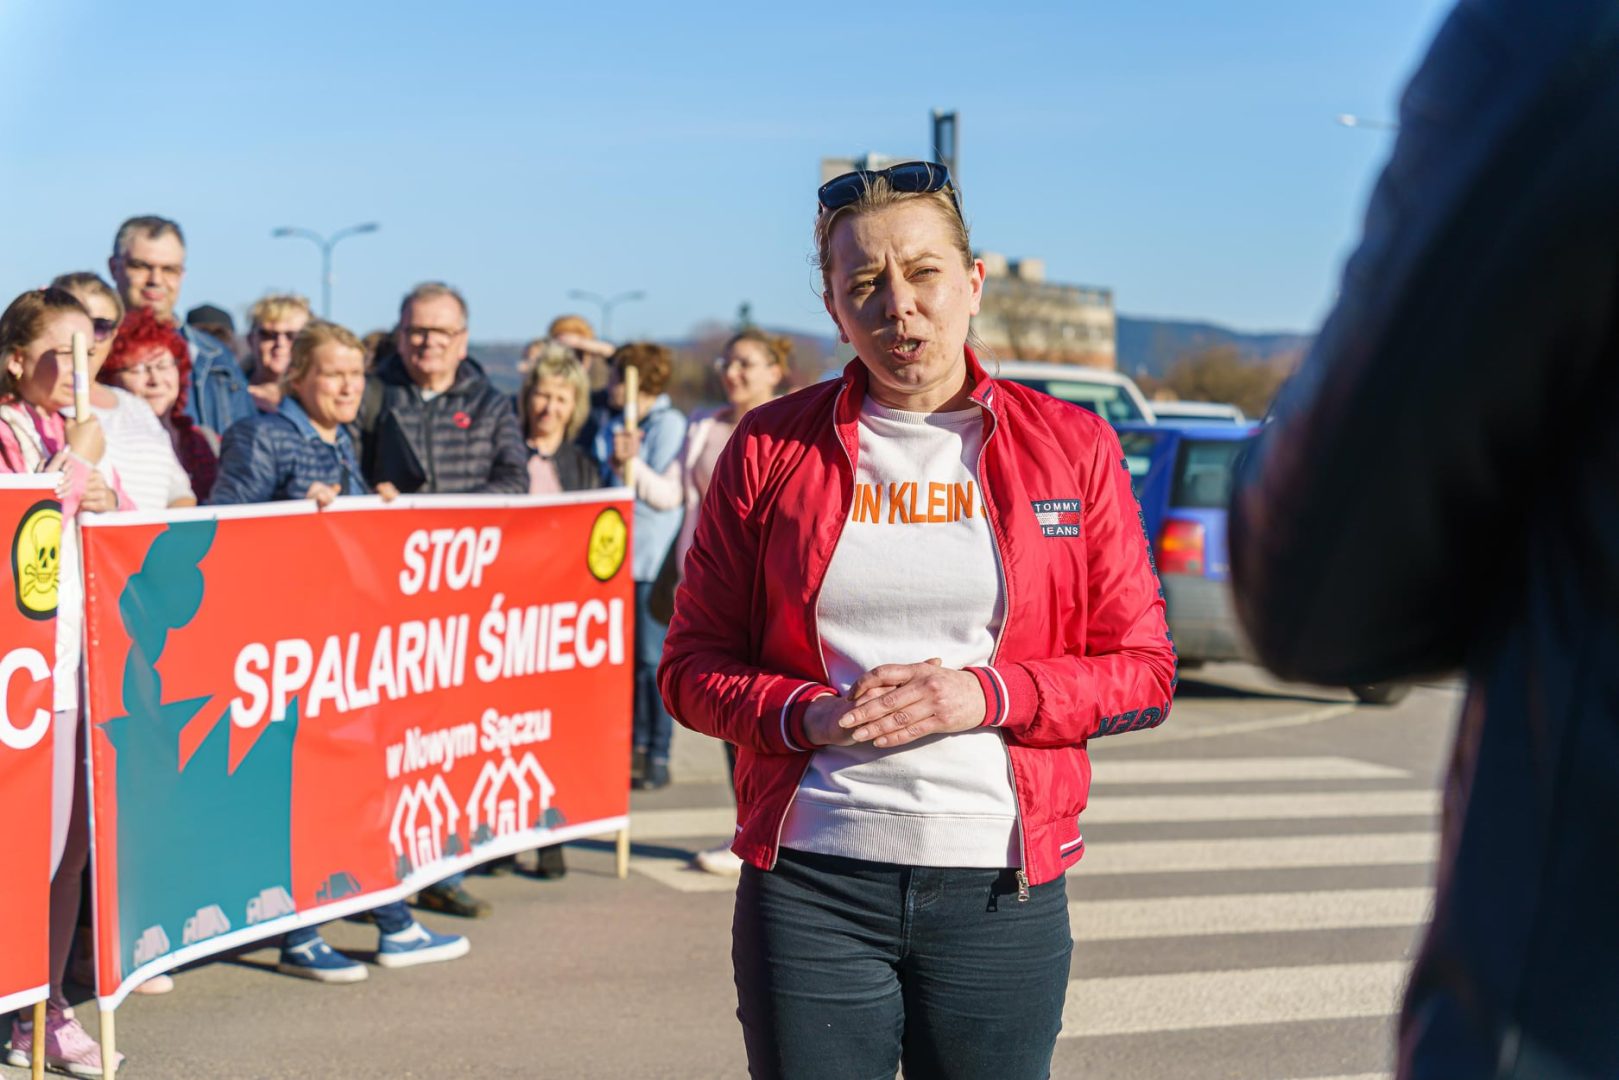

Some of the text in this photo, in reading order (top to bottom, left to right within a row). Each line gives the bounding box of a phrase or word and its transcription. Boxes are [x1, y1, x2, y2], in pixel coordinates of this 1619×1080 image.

[888, 480, 973, 524] KLEIN
[1034, 502, 1078, 512] TOMMY
[399, 527, 501, 595] STOP
[230, 592, 624, 728] SPALARNI ŚMIECI
[403, 727, 477, 772] Nowym
[480, 708, 551, 757] Sączu
